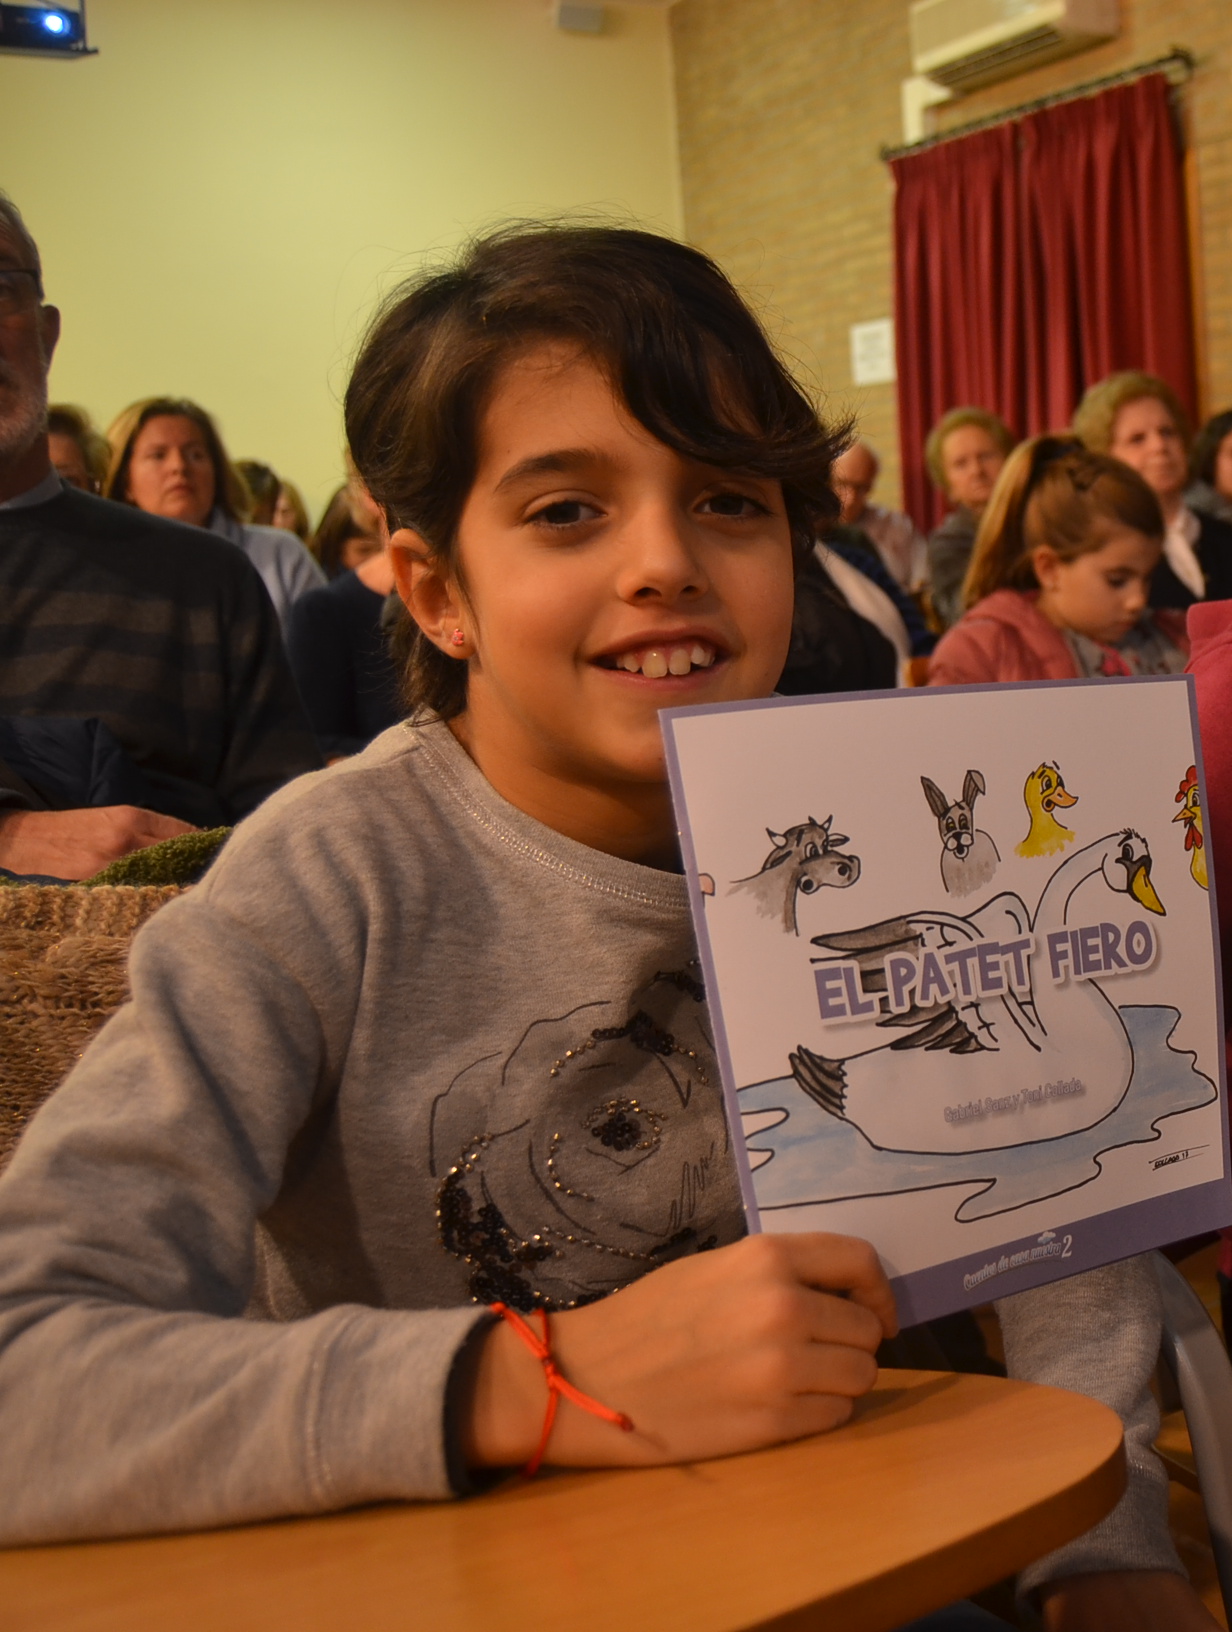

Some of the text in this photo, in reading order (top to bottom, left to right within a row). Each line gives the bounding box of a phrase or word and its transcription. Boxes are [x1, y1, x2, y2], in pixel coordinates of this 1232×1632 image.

[812, 920, 1154, 1020] EL PATET FIERO
[943, 1098, 982, 1123] Gabriel
[984, 1096, 1011, 1114] Sanz
[1021, 1084, 1043, 1105] Toni
[1045, 1077, 1083, 1099] Collada
[1061, 1234, 1073, 1259] 2
